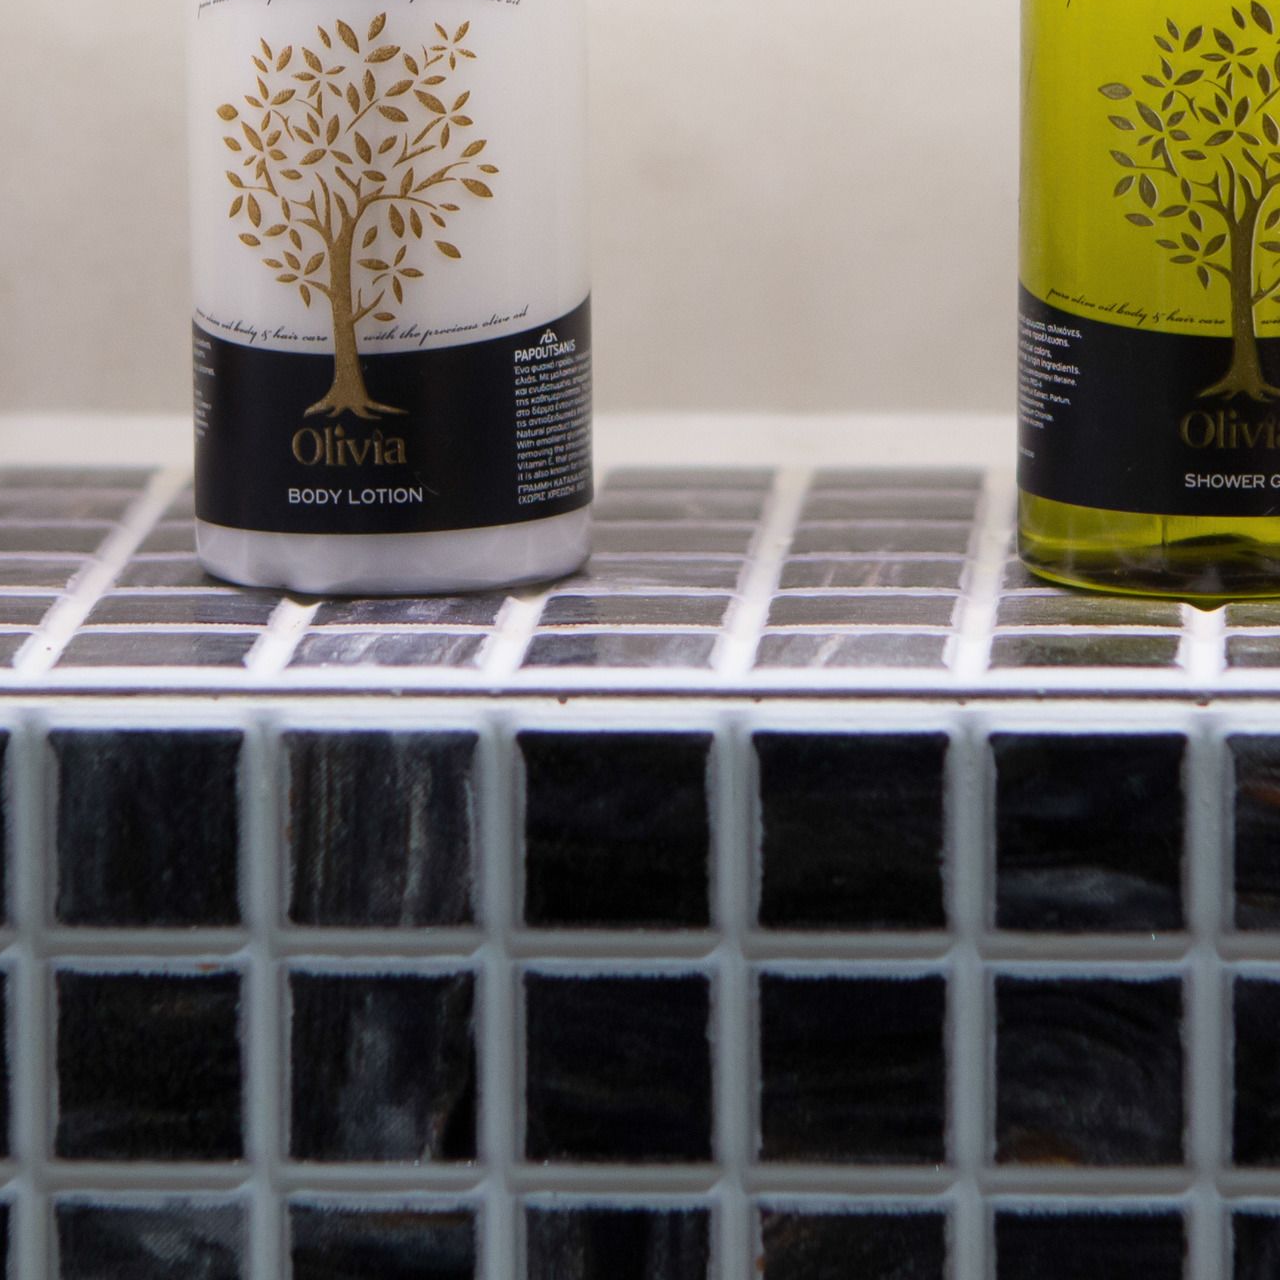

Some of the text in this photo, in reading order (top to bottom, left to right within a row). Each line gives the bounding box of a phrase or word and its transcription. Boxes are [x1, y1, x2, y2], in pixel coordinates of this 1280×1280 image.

[1071, 294, 1095, 308] olive
[1098, 302, 1118, 313] oil
[1116, 301, 1148, 326] body
[1166, 308, 1194, 324] hair
[234, 319, 258, 344] body
[273, 325, 299, 341] hair
[302, 334, 328, 342] care
[363, 324, 398, 341] with
[399, 323, 421, 340] the
[418, 324, 478, 346] precious
[482, 313, 510, 328] olive
[512, 304, 529, 318] oil
[516, 427, 545, 439] Natural
[292, 424, 408, 465] Olivia
[516, 440, 535, 450] With
[517, 460, 547, 471] Vitamin
[1184, 473, 1266, 489] SHOWER
[288, 487, 424, 505] BODY LOTION
